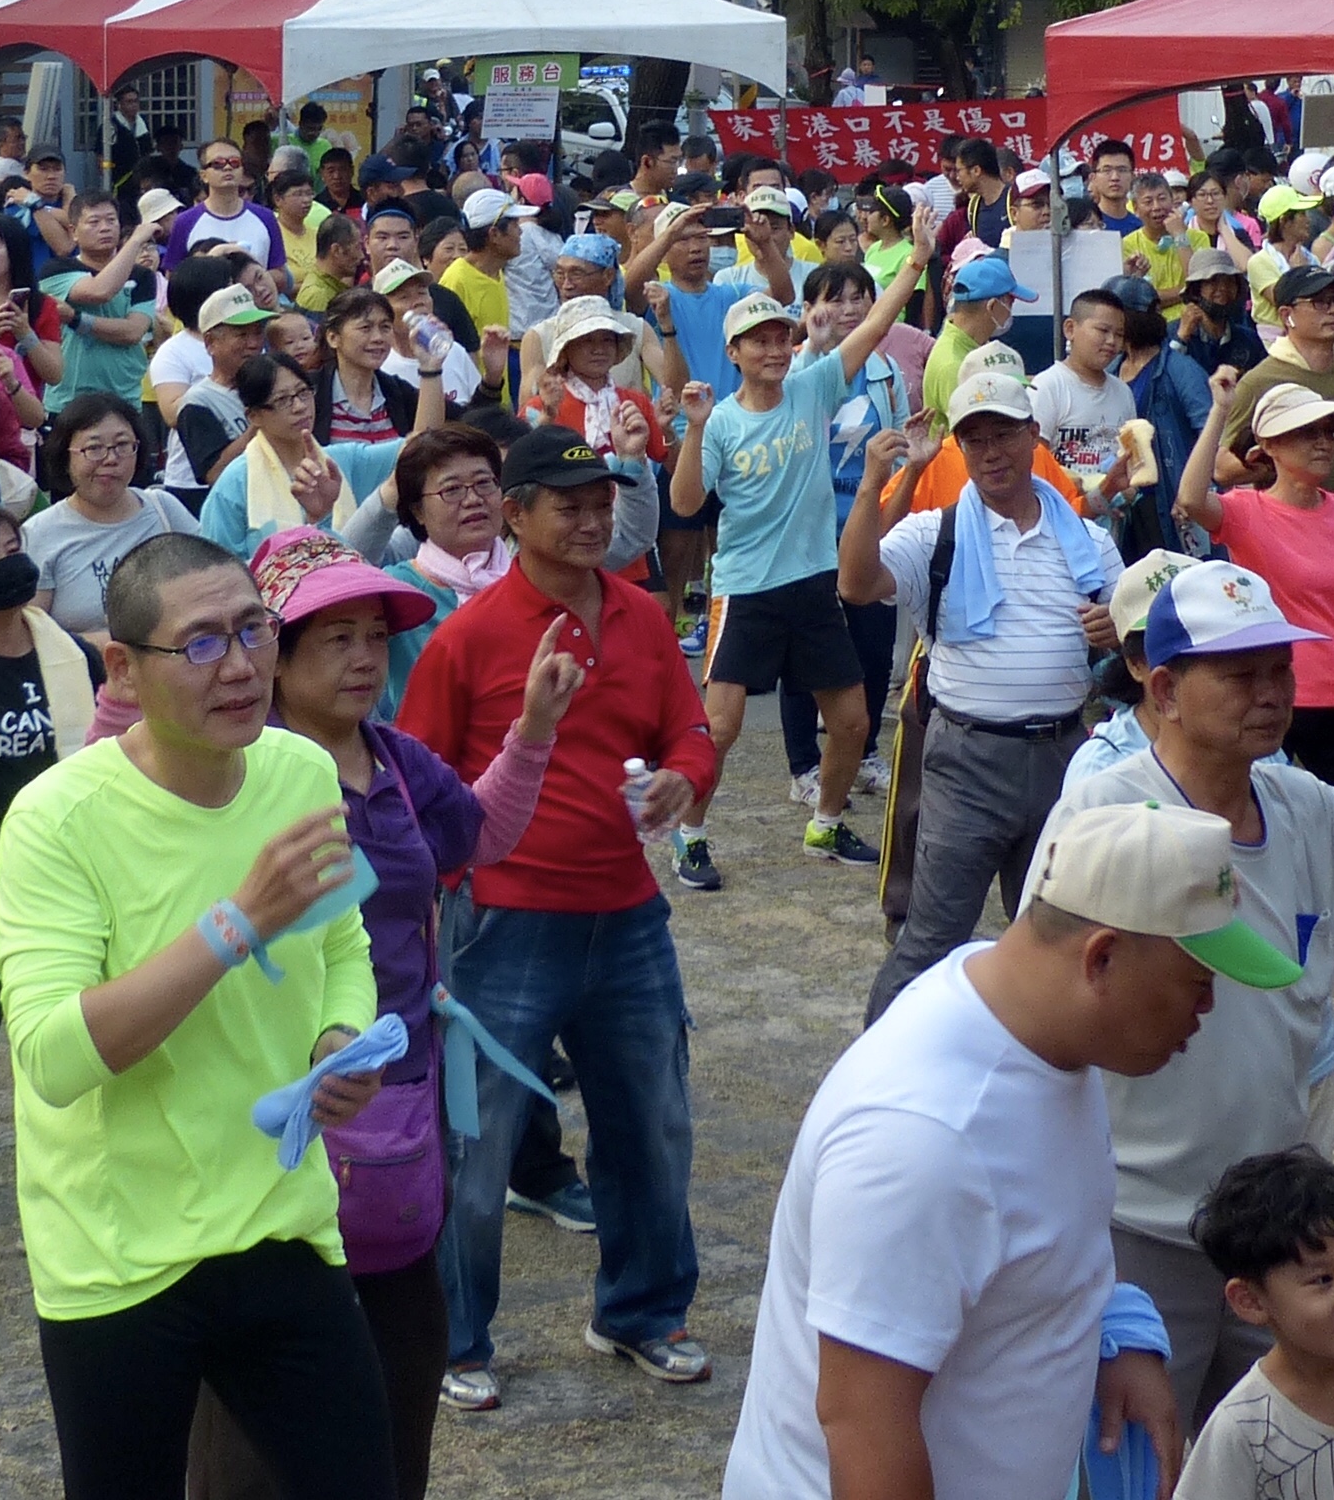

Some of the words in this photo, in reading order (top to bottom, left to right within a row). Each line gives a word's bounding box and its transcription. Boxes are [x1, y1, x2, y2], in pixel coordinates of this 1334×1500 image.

[493, 63, 560, 84] 服務台
[727, 107, 1027, 142] 家是港口不是傷口
[1058, 428, 1090, 443] THE
[23, 682, 42, 704] I
